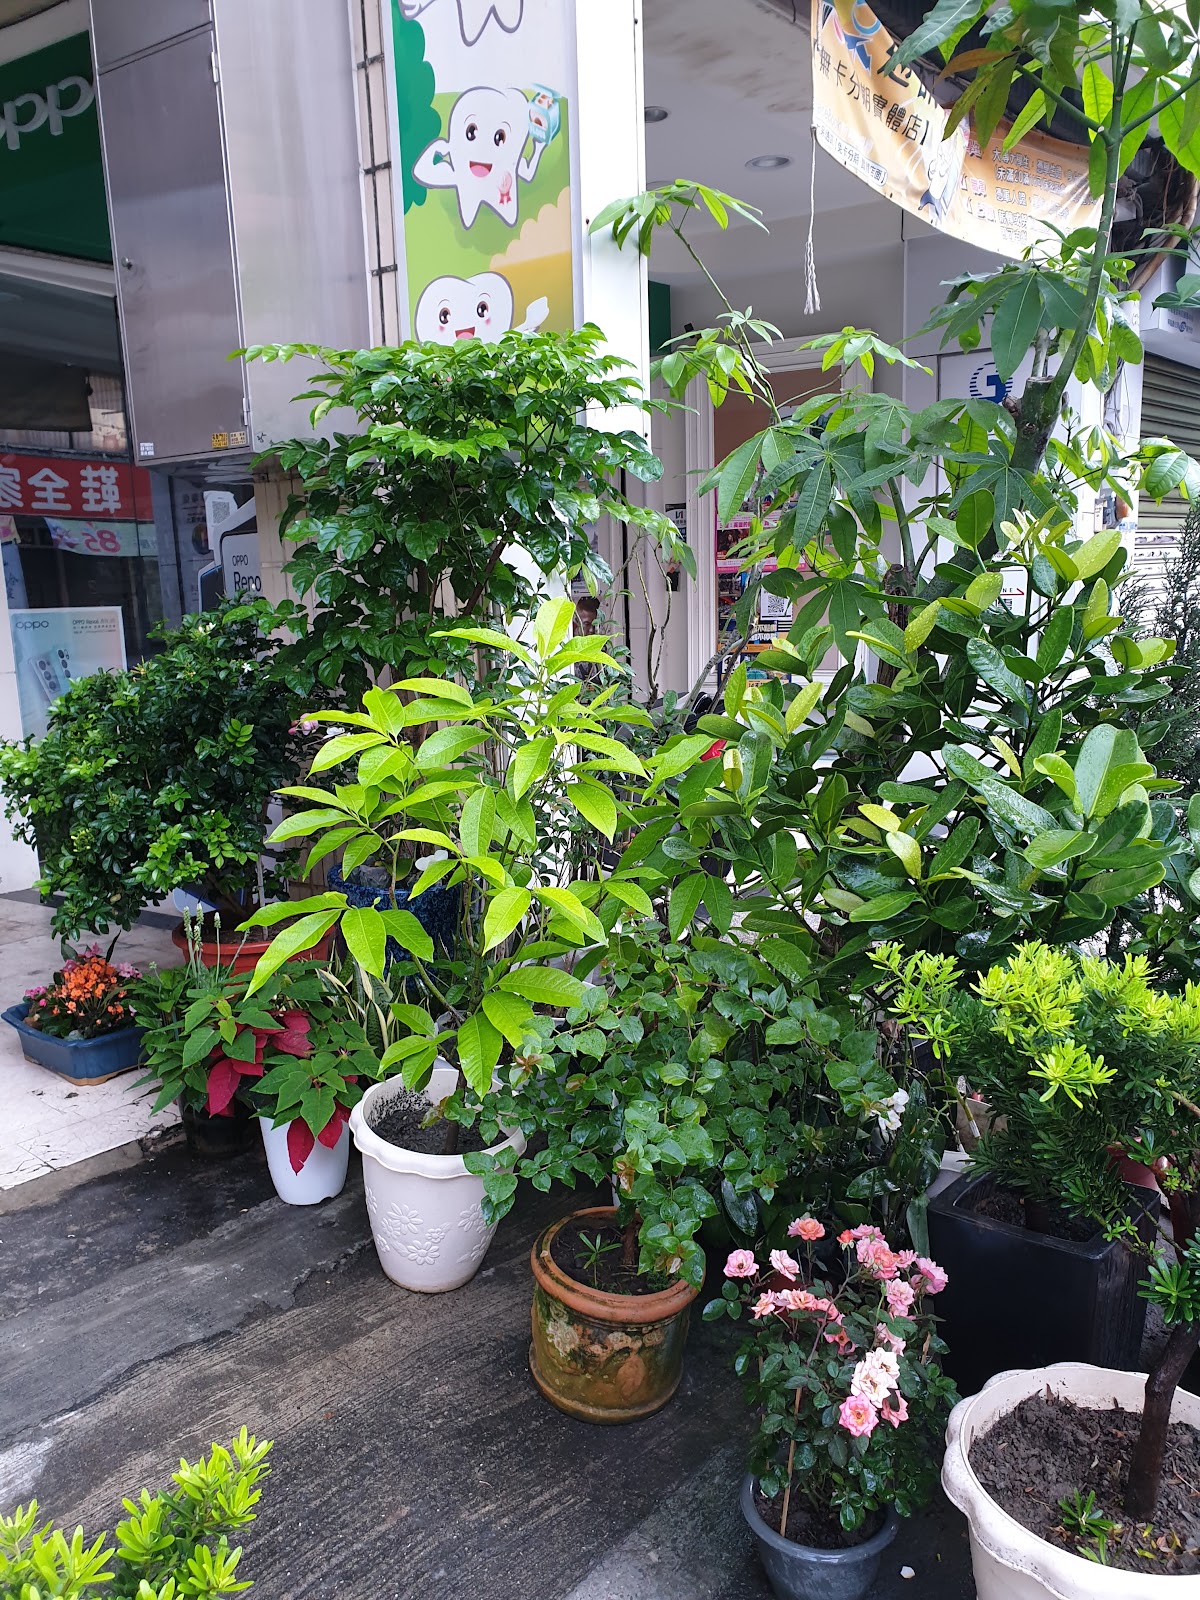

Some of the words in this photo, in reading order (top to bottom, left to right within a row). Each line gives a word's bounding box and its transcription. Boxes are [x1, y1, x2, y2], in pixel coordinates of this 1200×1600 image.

[0, 75, 95, 151] pp
[231, 554, 249, 567] OPPO
[233, 571, 262, 592] Reno
[15, 620, 49, 631] oppo
